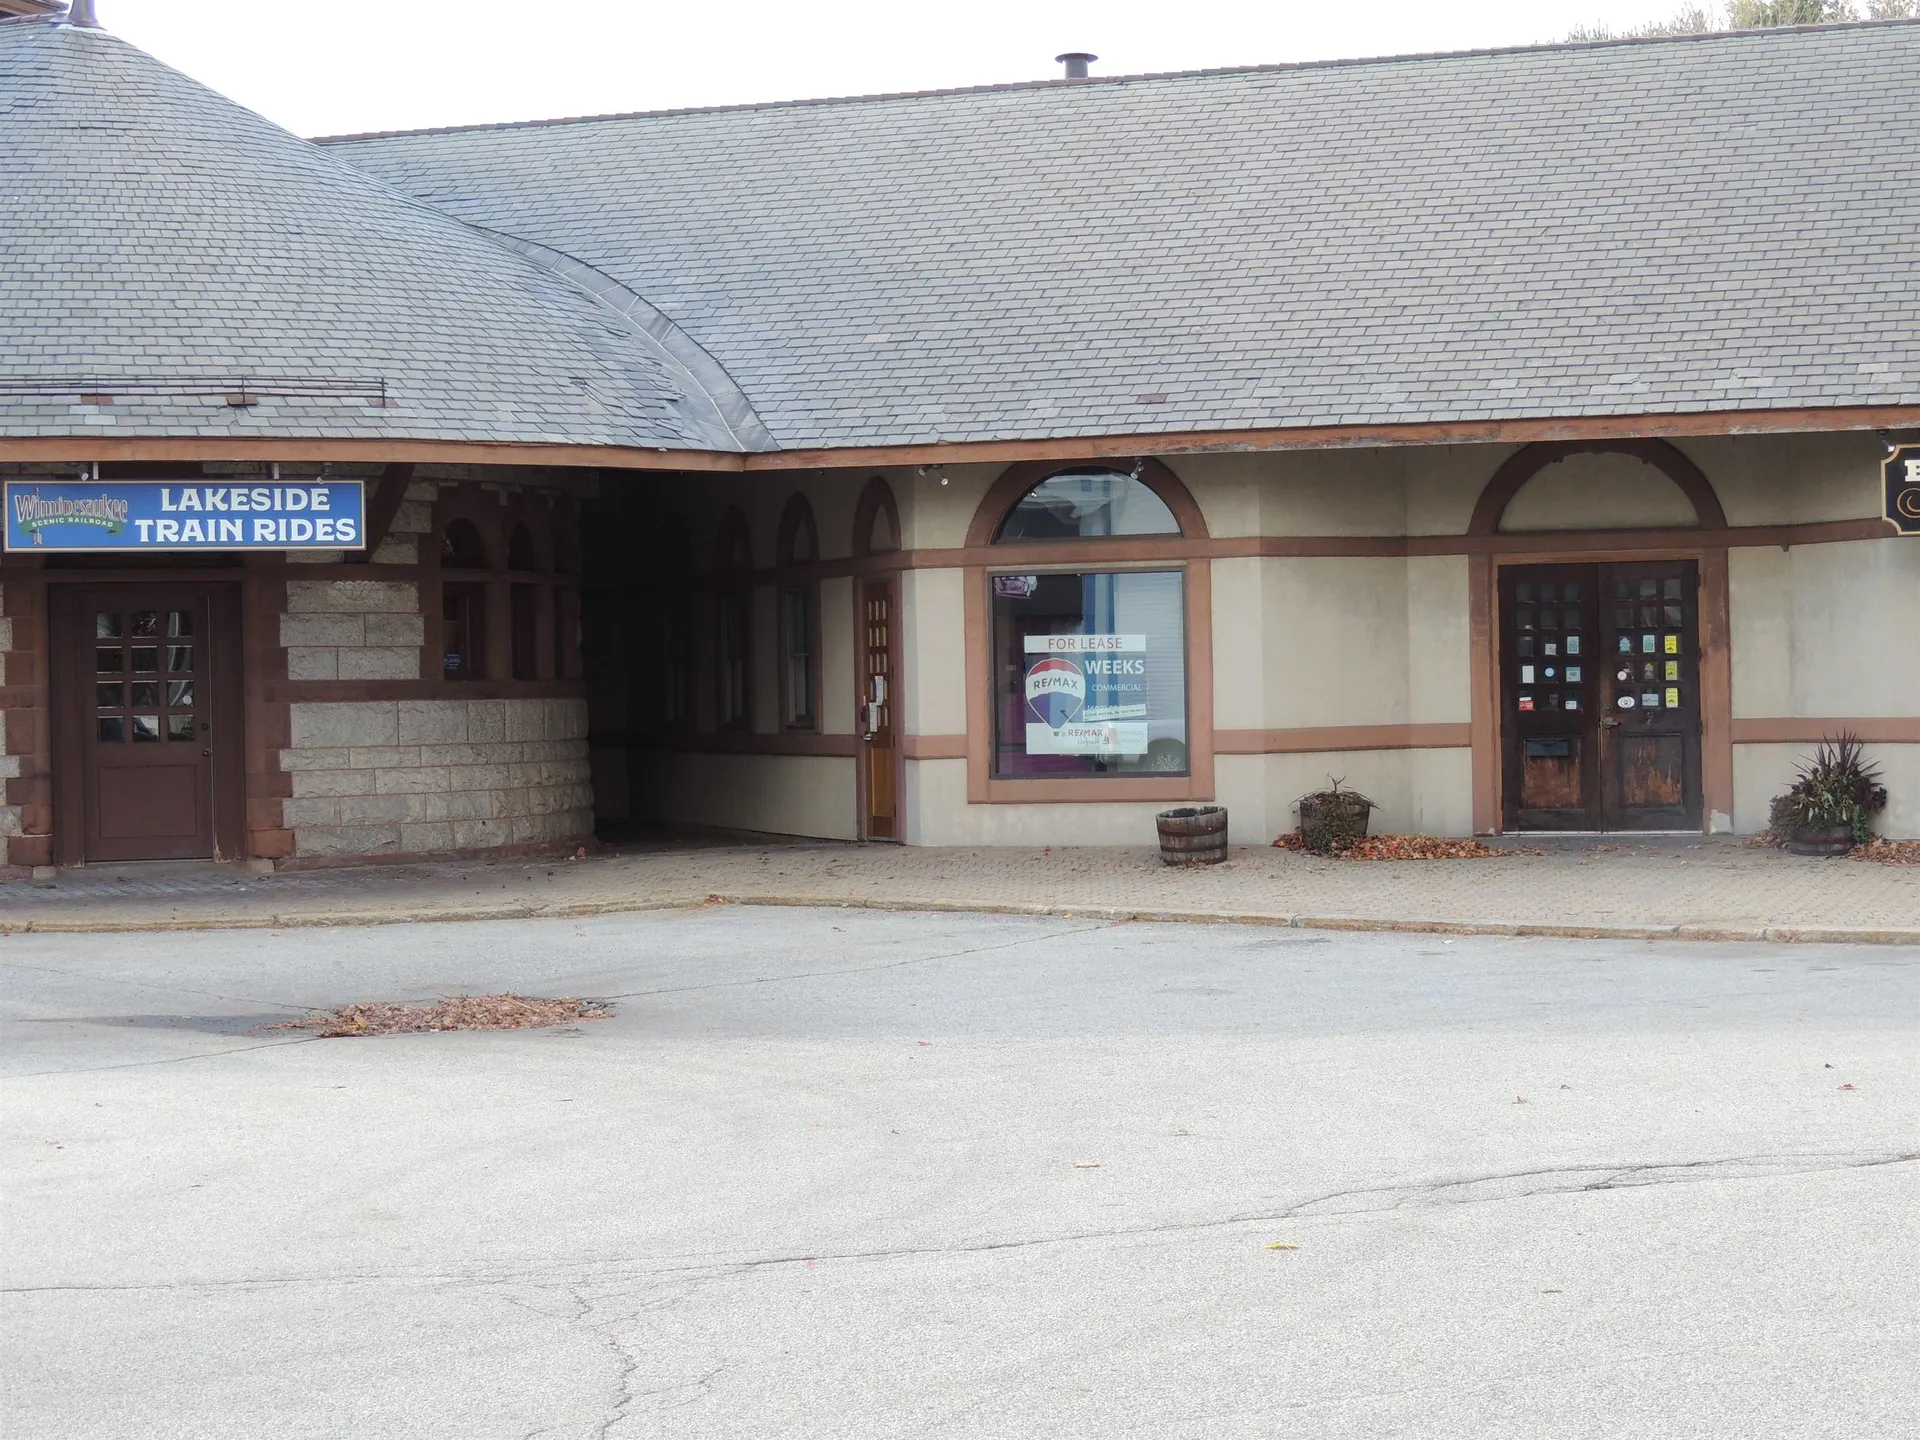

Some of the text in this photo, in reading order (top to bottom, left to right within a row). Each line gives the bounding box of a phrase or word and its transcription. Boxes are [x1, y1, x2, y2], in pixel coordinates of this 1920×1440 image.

[161, 488, 331, 511] LAKESIDE
[32, 517, 114, 528] SCENIC RAILROAD
[135, 518, 356, 542] TRAIN RIDES
[1048, 638, 1123, 650] FOR LEASE
[1085, 660, 1145, 675] WEEKS
[1033, 677, 1078, 690] RE/MAX
[1091, 684, 1142, 692] COMMERCIAL
[1068, 729, 1103, 737] RE/MAX
